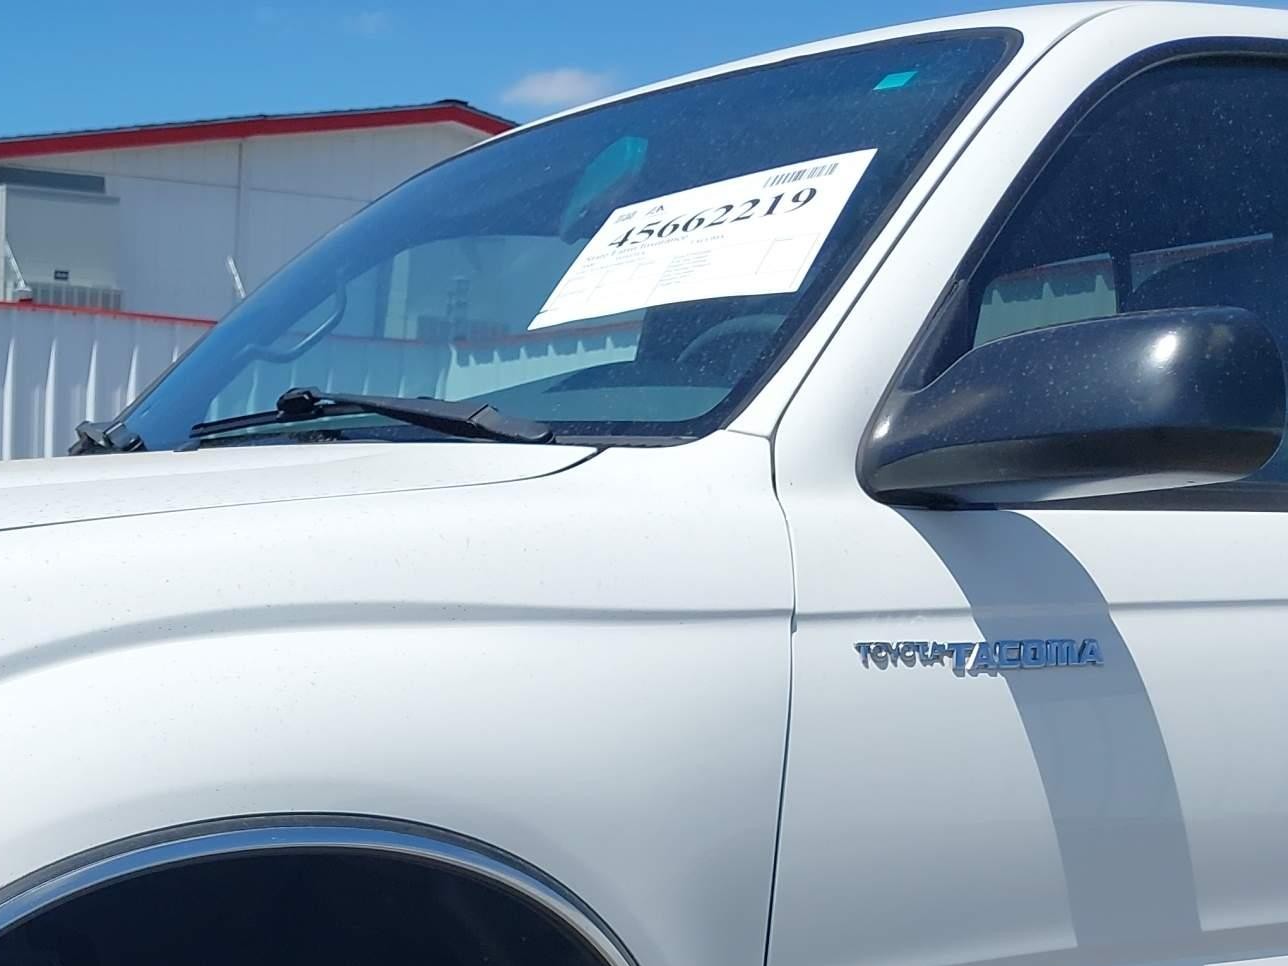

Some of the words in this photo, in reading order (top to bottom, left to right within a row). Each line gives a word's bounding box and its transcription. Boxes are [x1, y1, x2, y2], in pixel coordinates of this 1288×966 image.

[608, 187, 817, 248] 45662219
[854, 640, 945, 667] TOYOTA
[944, 638, 1105, 671] TACOMA
